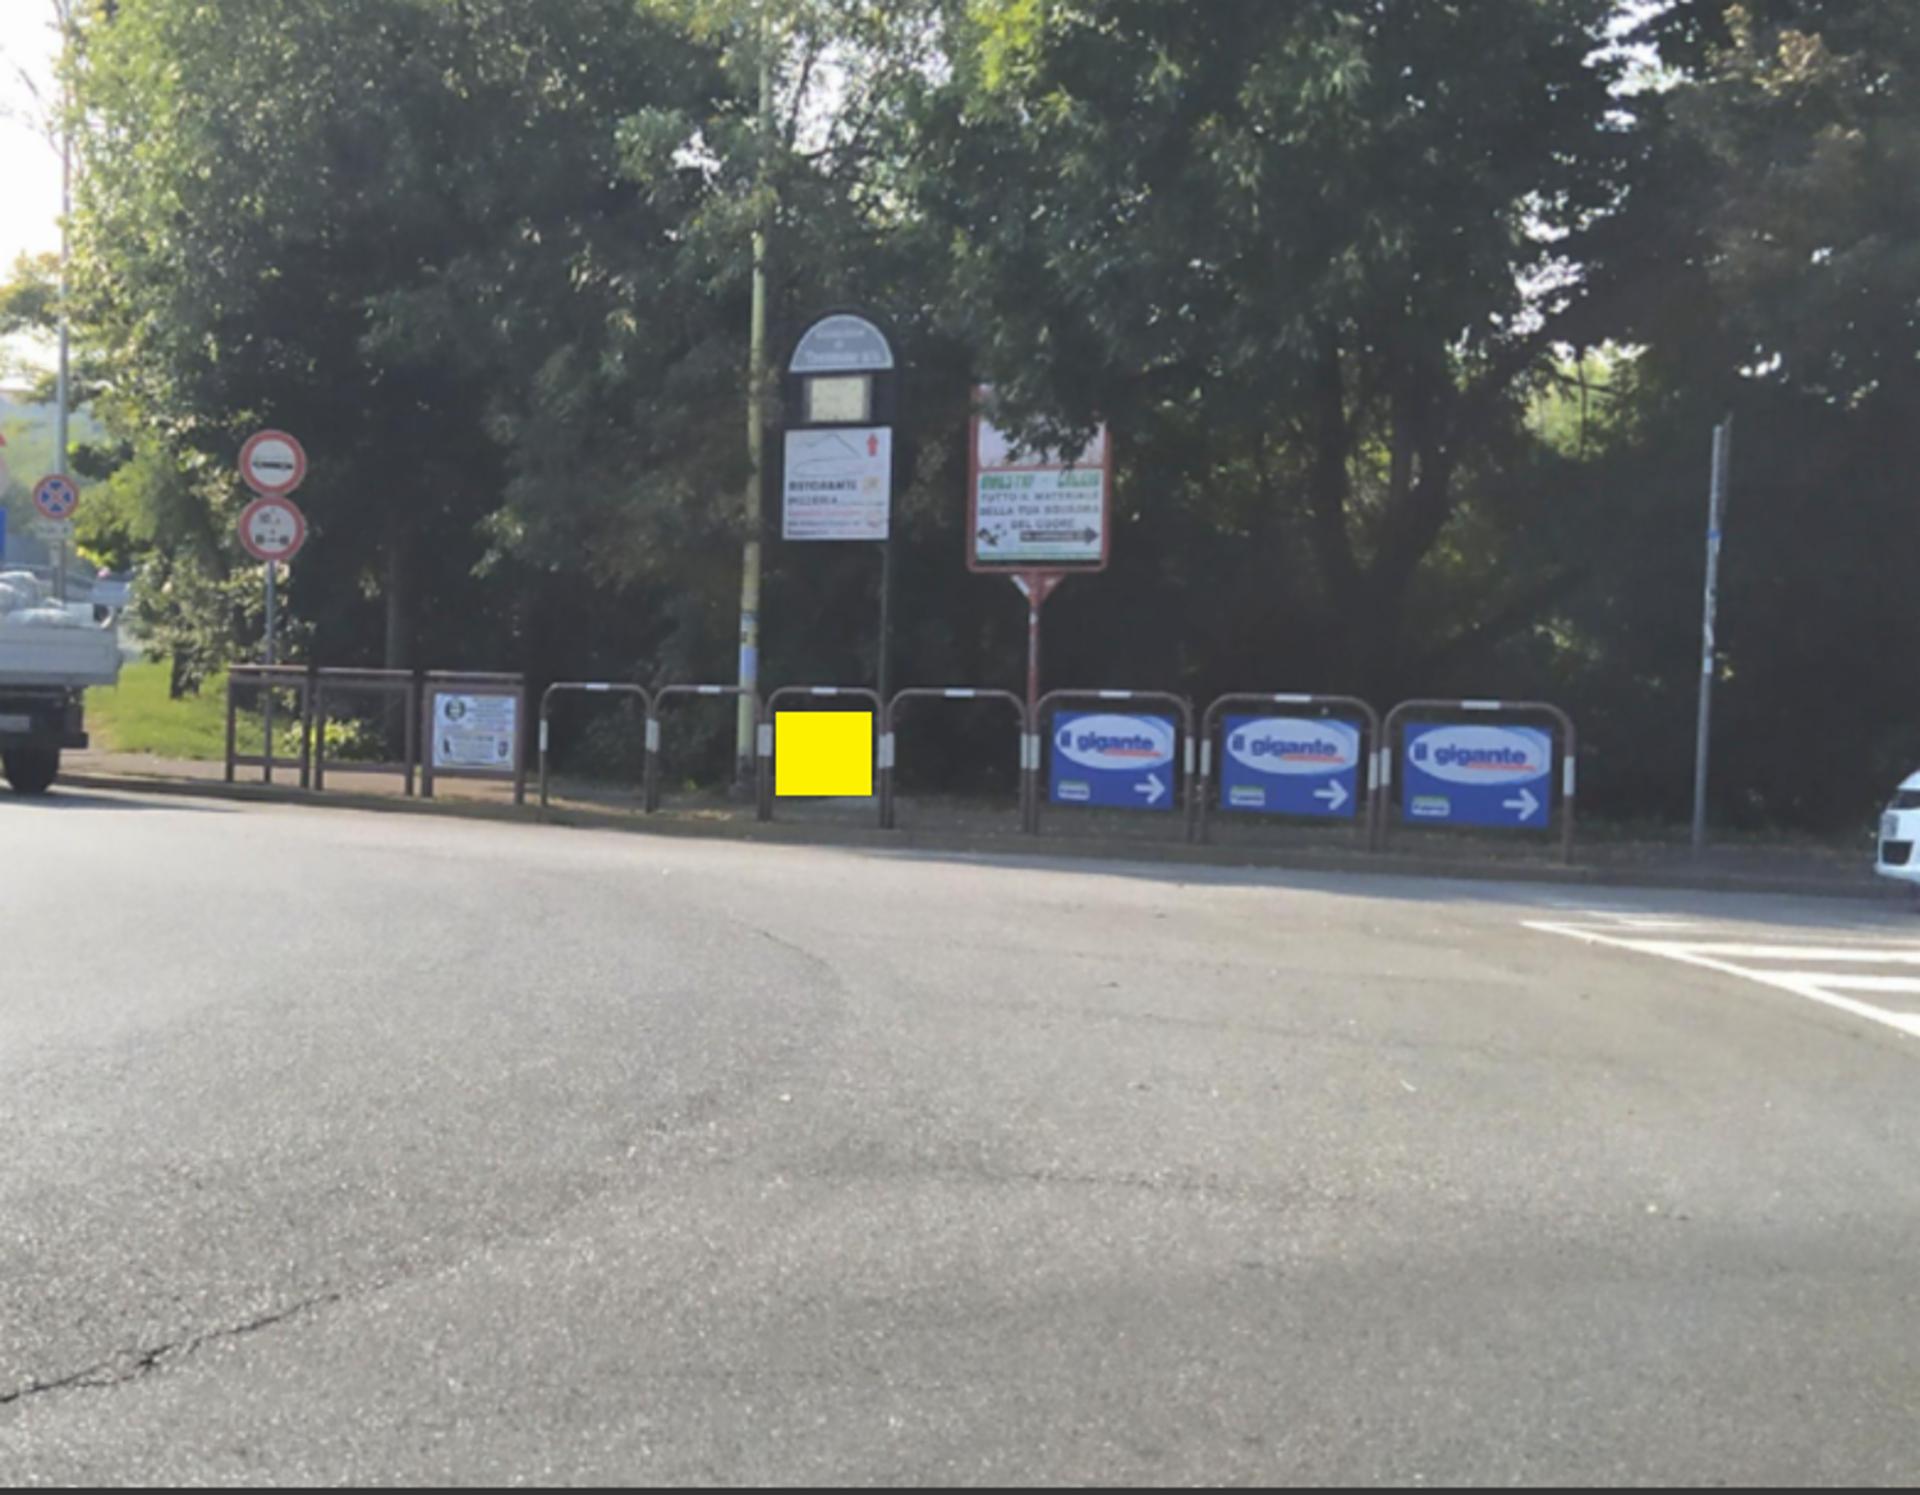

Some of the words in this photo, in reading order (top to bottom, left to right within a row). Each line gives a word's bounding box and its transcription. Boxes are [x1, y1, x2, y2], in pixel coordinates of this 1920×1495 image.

[788, 480, 857, 492] RISTORANTE
[1060, 730, 1072, 749] il
[1077, 731, 1155, 754] gigante
[1232, 733, 1245, 752] il
[1251, 735, 1338, 758] gigante
[1414, 742, 1428, 761] il
[1434, 743, 1527, 767] gigante
